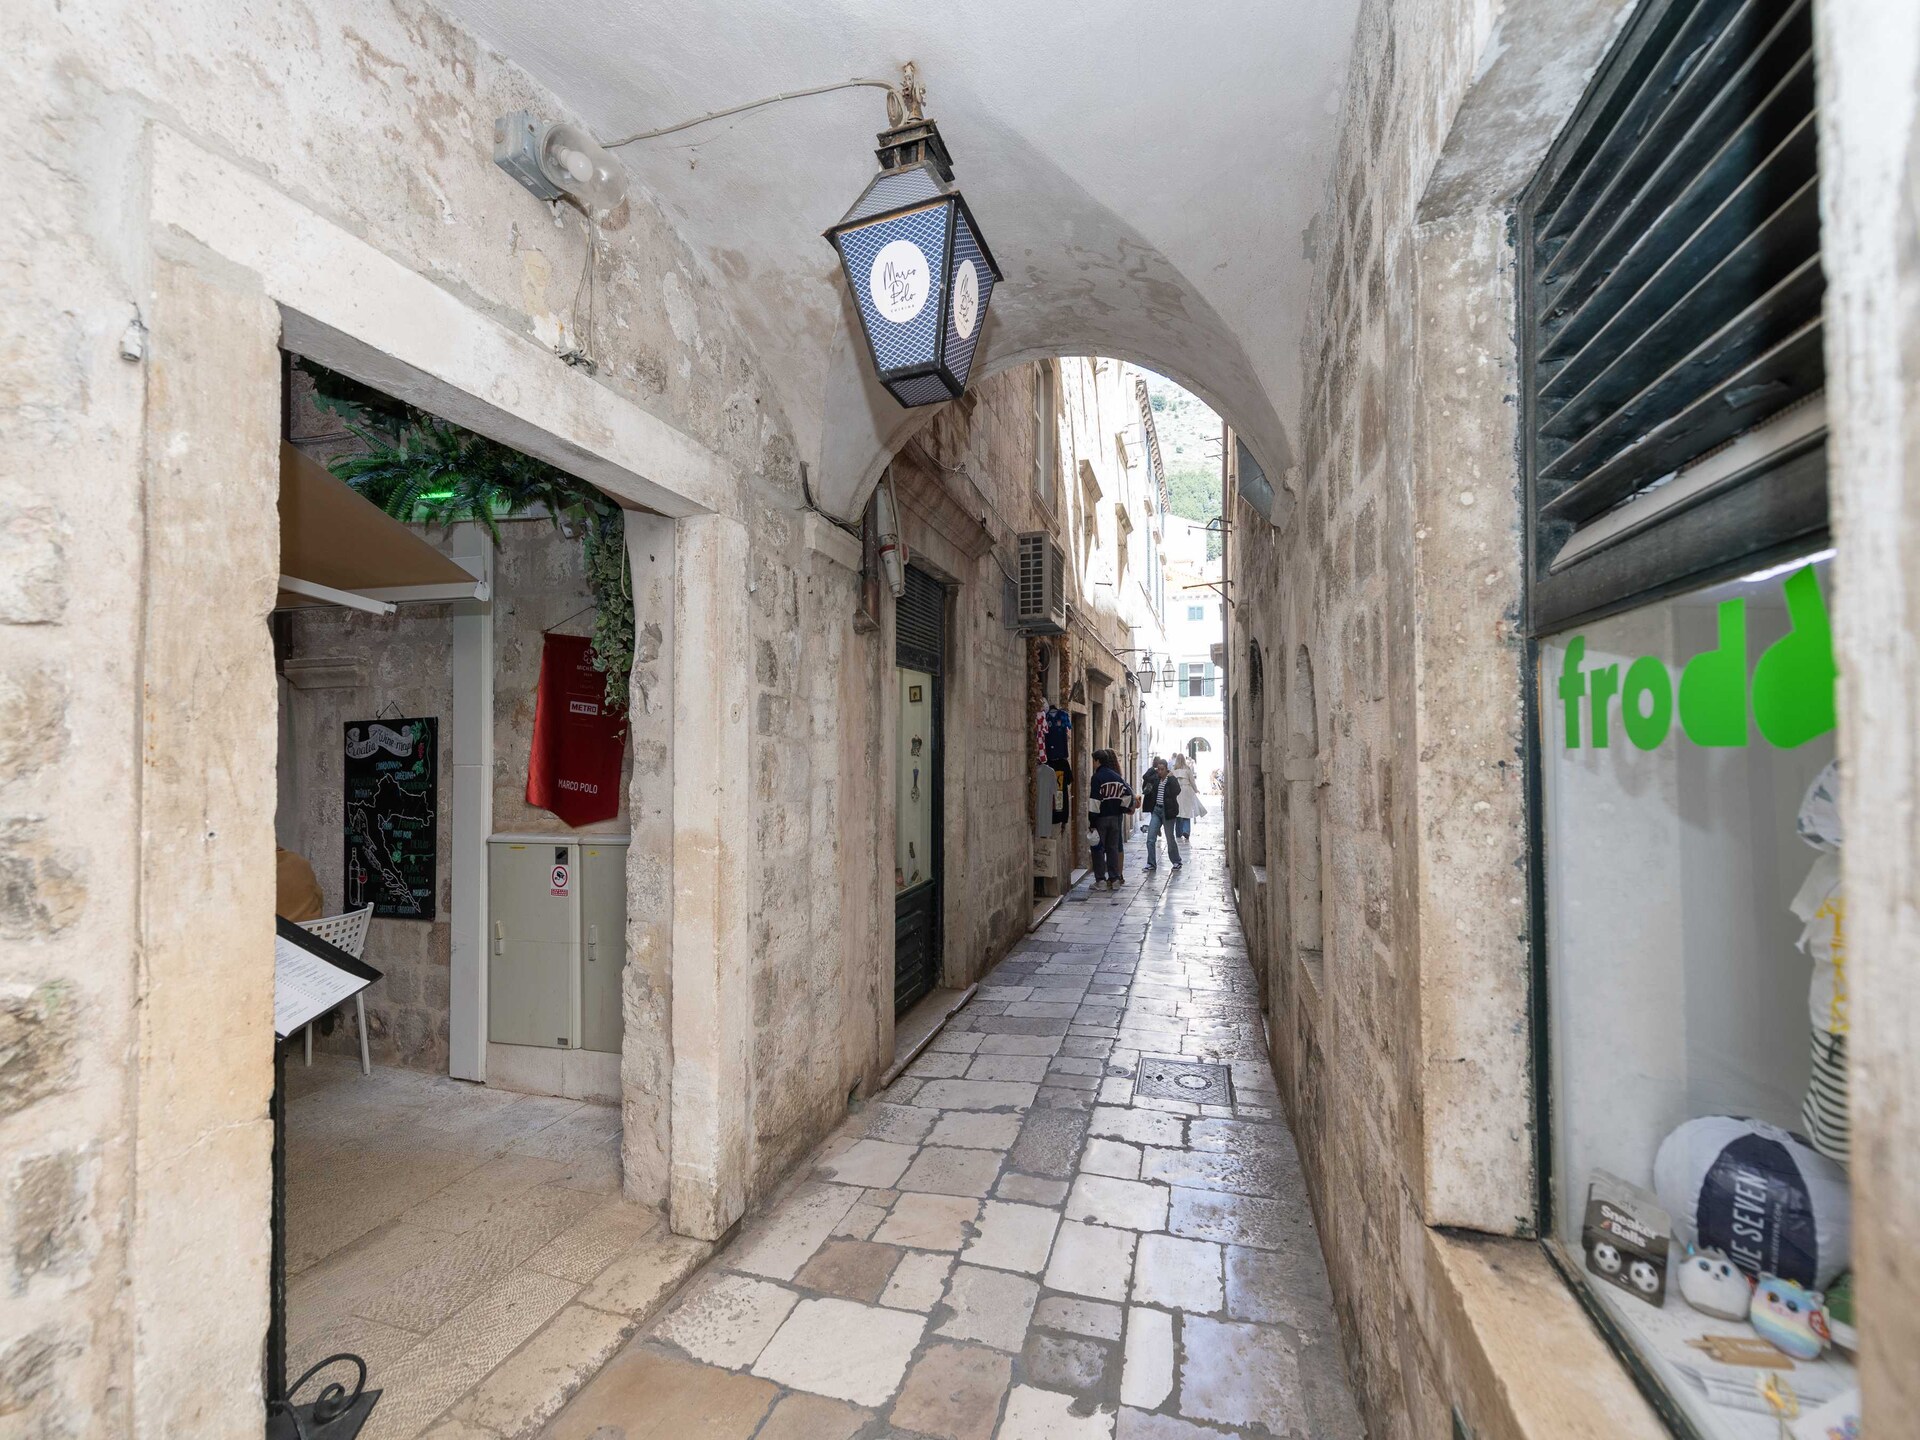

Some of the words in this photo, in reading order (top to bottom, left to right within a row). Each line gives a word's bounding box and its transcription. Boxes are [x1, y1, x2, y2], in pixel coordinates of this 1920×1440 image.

[883, 261, 916, 290] Marco
[888, 280, 916, 305] Polo
[571, 703, 597, 713] METRO
[347, 741, 376, 756] Croatia
[396, 741, 411, 753] map
[558, 779, 579, 791] MARCO
[580, 782, 598, 794] POLO
[1732, 1169, 1768, 1243] SEVEN
[1600, 1204, 1656, 1240] Sneaker
[1611, 1221, 1647, 1248] Balls
